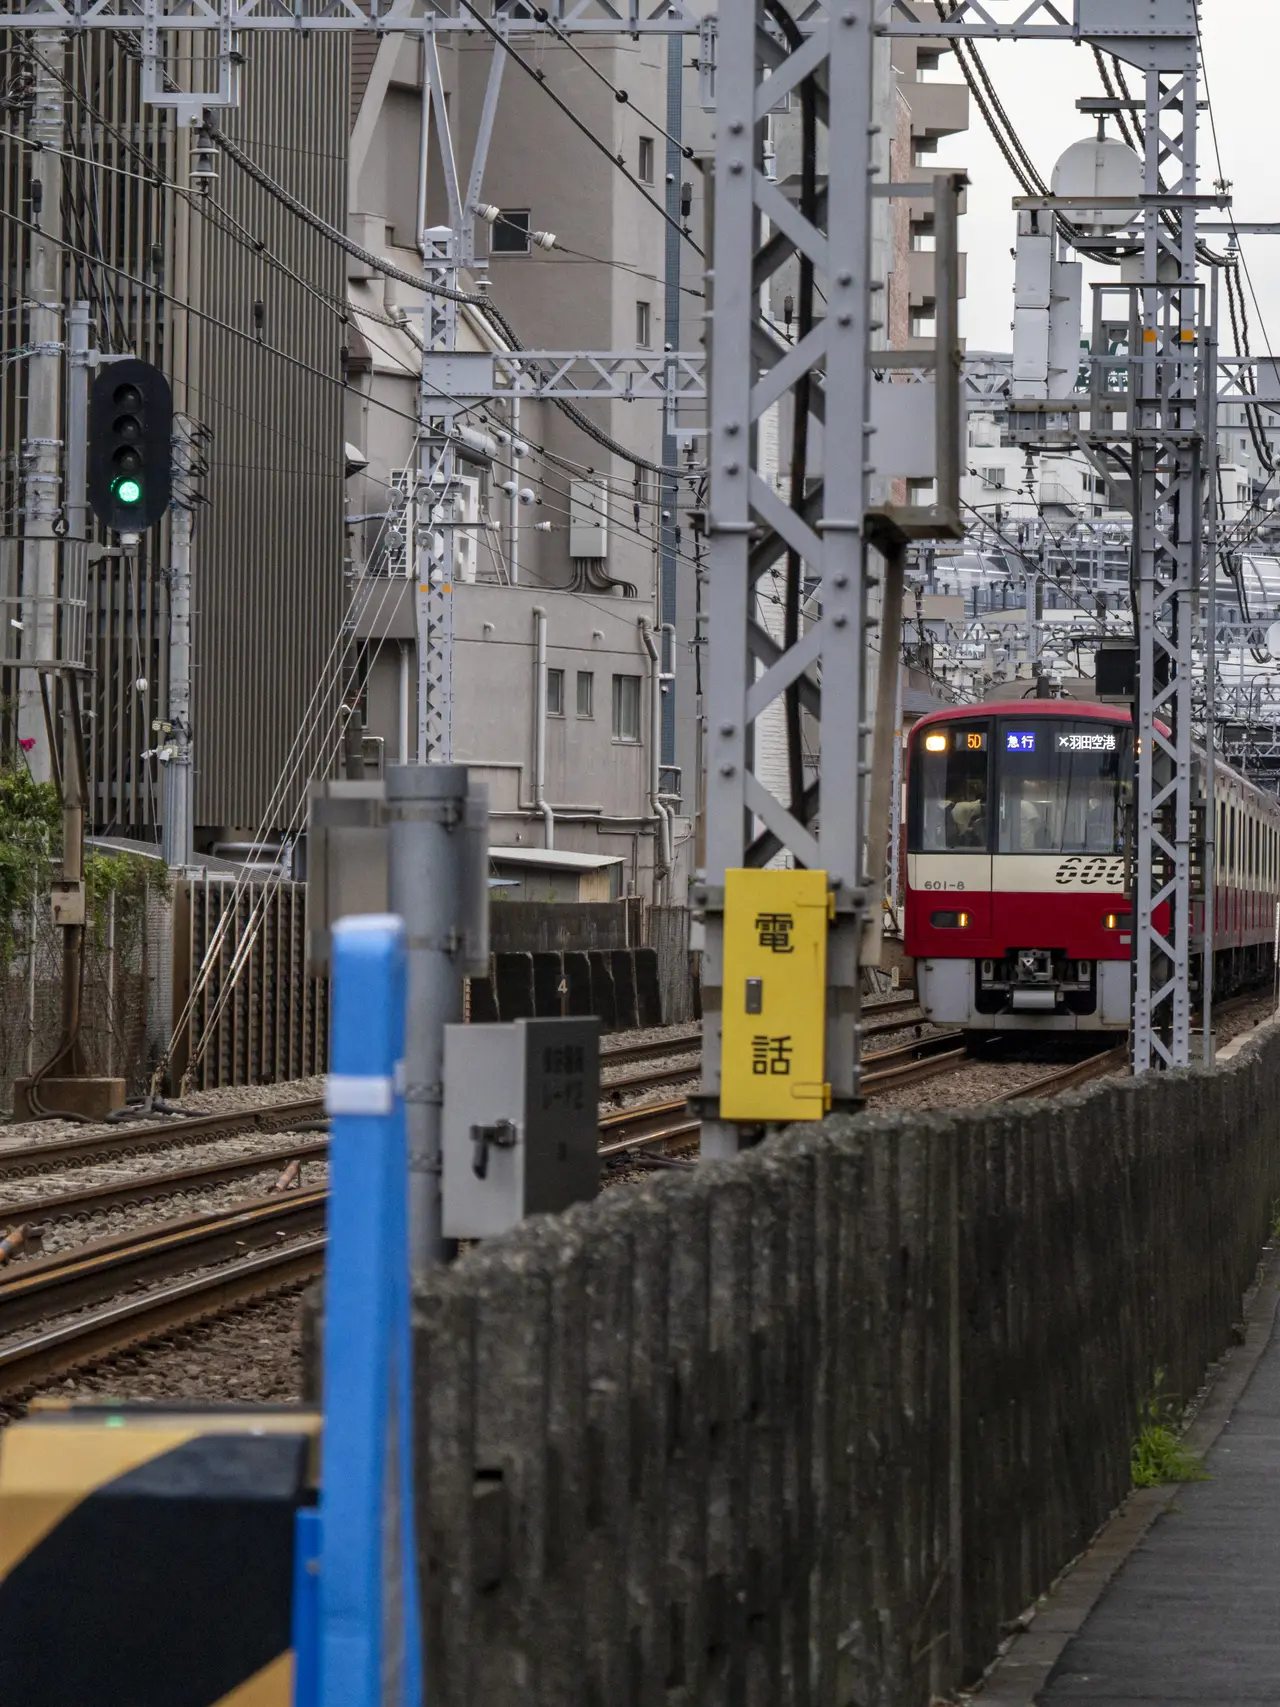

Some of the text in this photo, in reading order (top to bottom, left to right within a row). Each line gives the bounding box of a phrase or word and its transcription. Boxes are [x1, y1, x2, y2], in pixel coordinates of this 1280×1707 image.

[55, 519, 66, 534] 4
[967, 733, 982, 749] 5D
[1007, 735, 1034, 749] 急行
[1069, 734, 1116, 750] 羽田空港
[924, 880, 965, 890] 601-8
[557, 978, 568, 994] 4
[751, 912, 795, 1076] 電話
